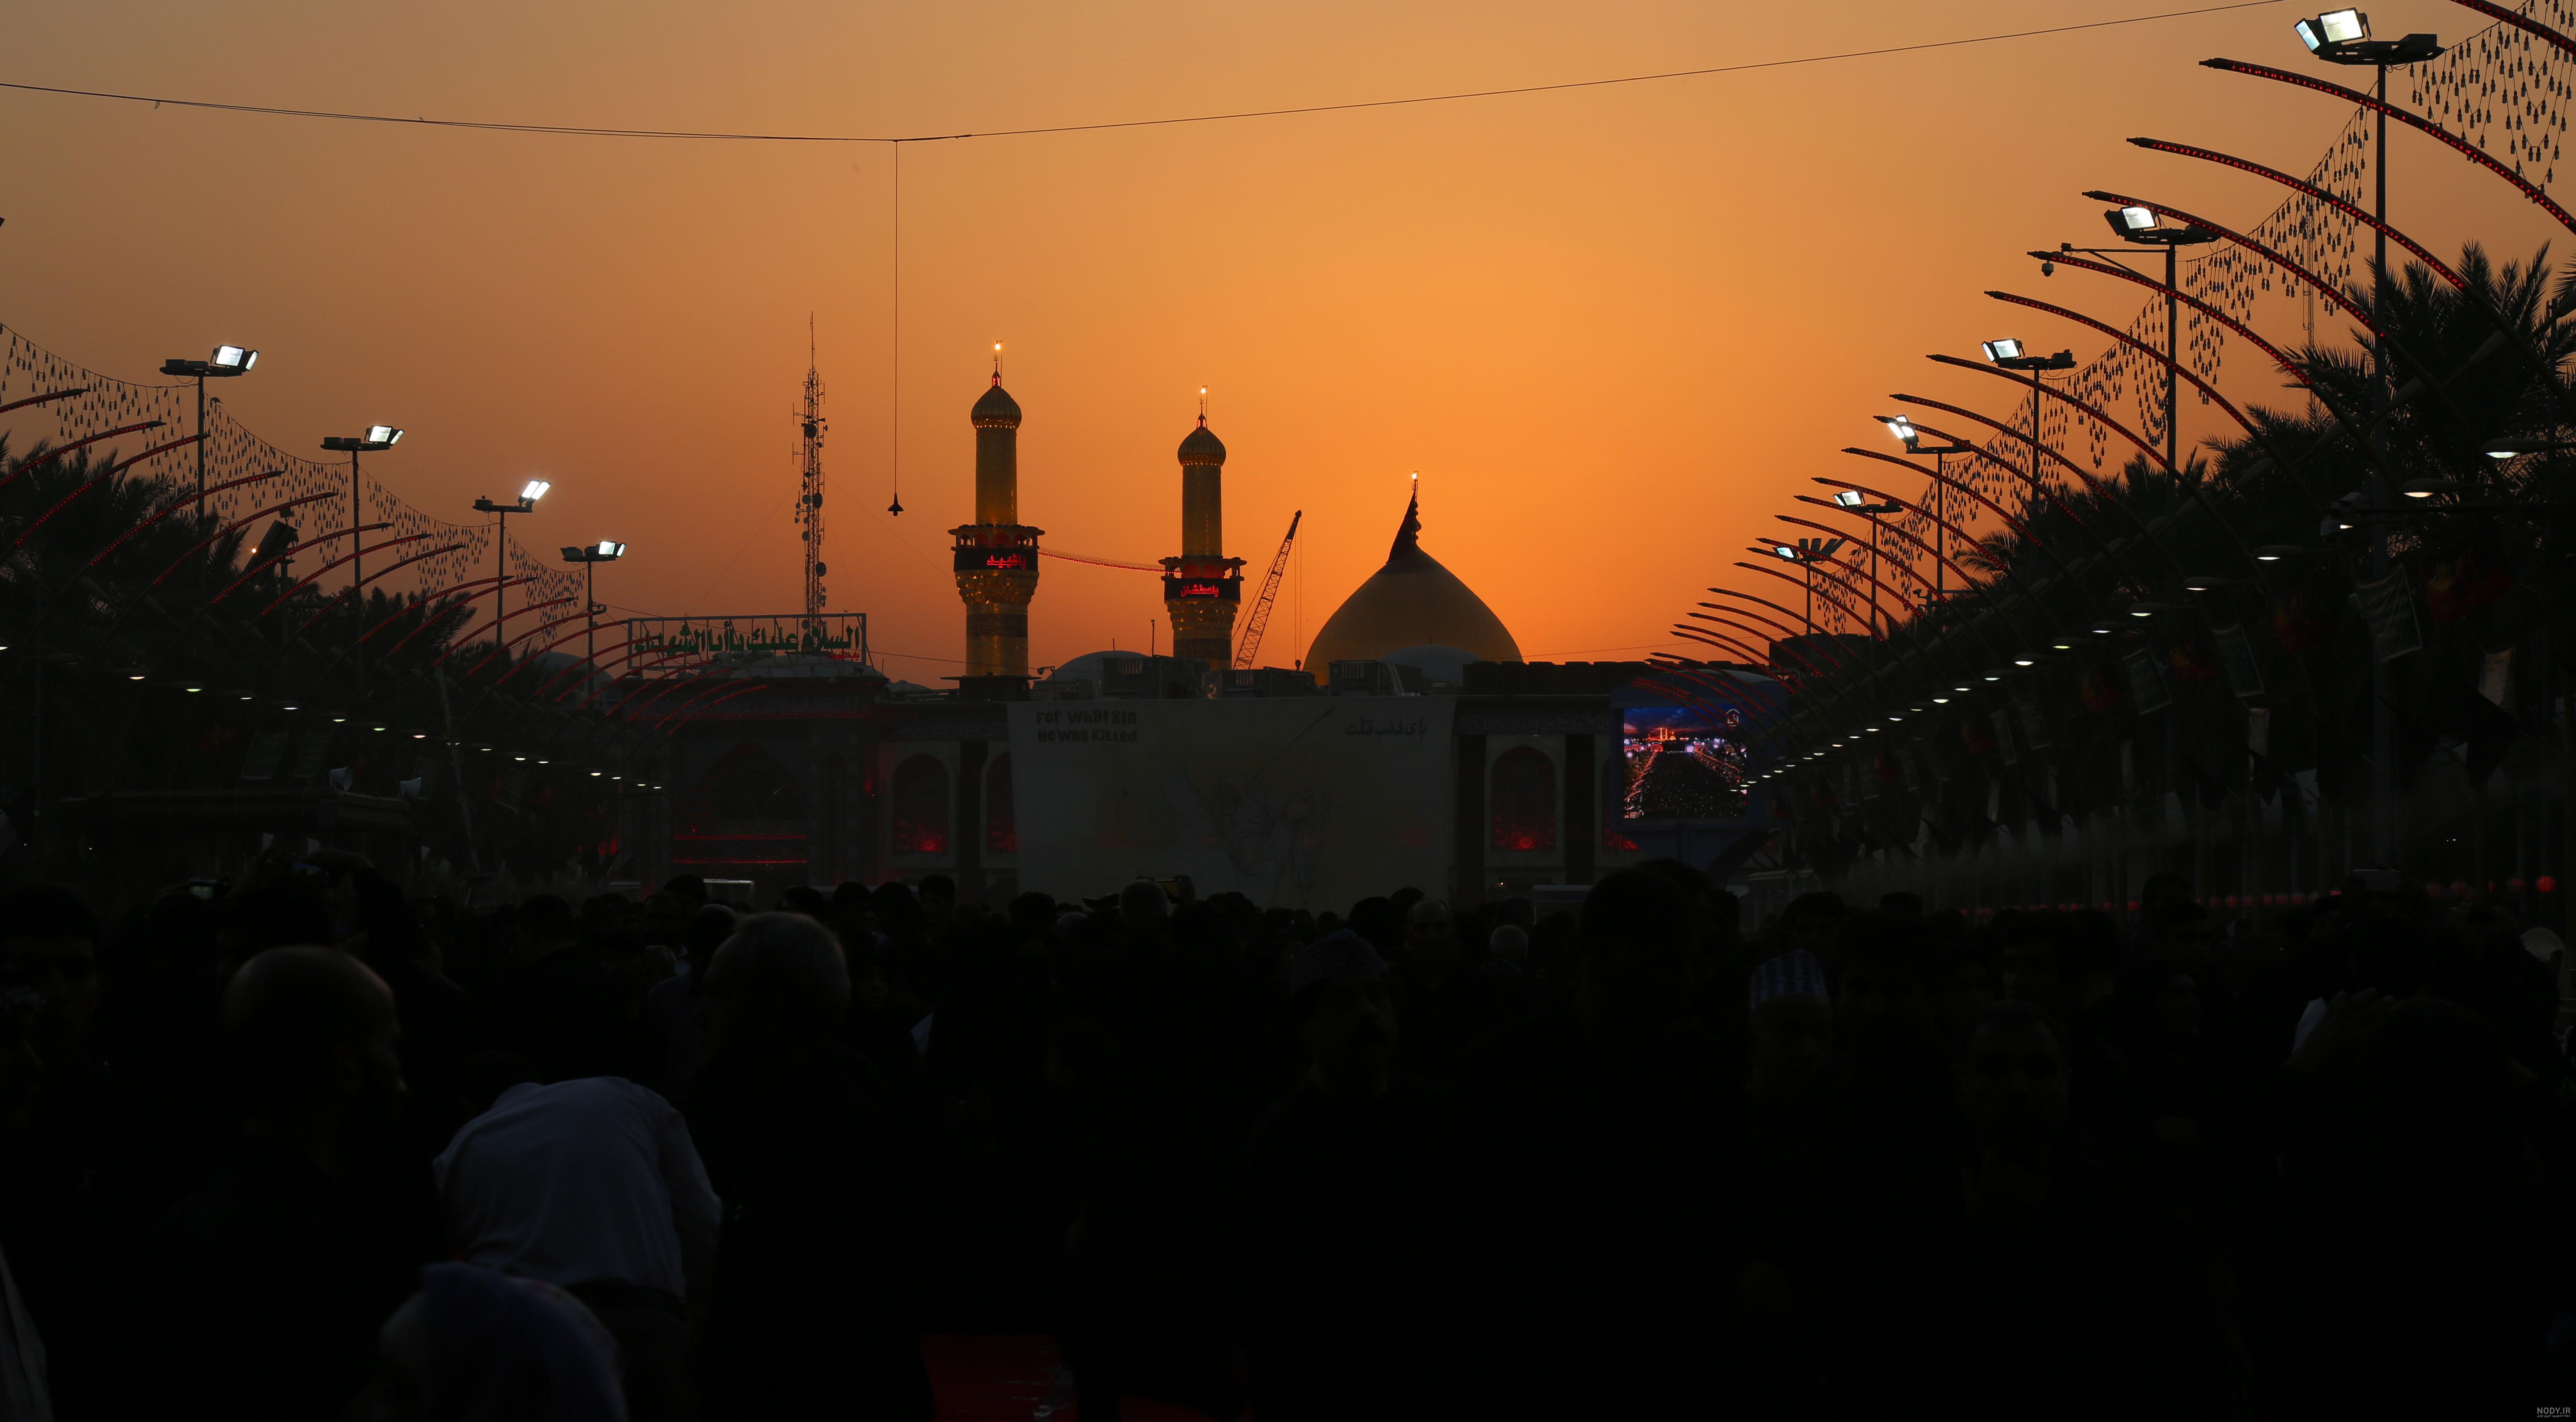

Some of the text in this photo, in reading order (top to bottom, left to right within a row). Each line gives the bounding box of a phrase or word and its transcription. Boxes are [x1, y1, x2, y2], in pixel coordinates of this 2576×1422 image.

[746, 626, 798, 659] عليك
[801, 620, 860, 657] السلام
[1036, 710, 1062, 724] For
[1066, 709, 1109, 724] What
[1038, 729, 1055, 742] He
